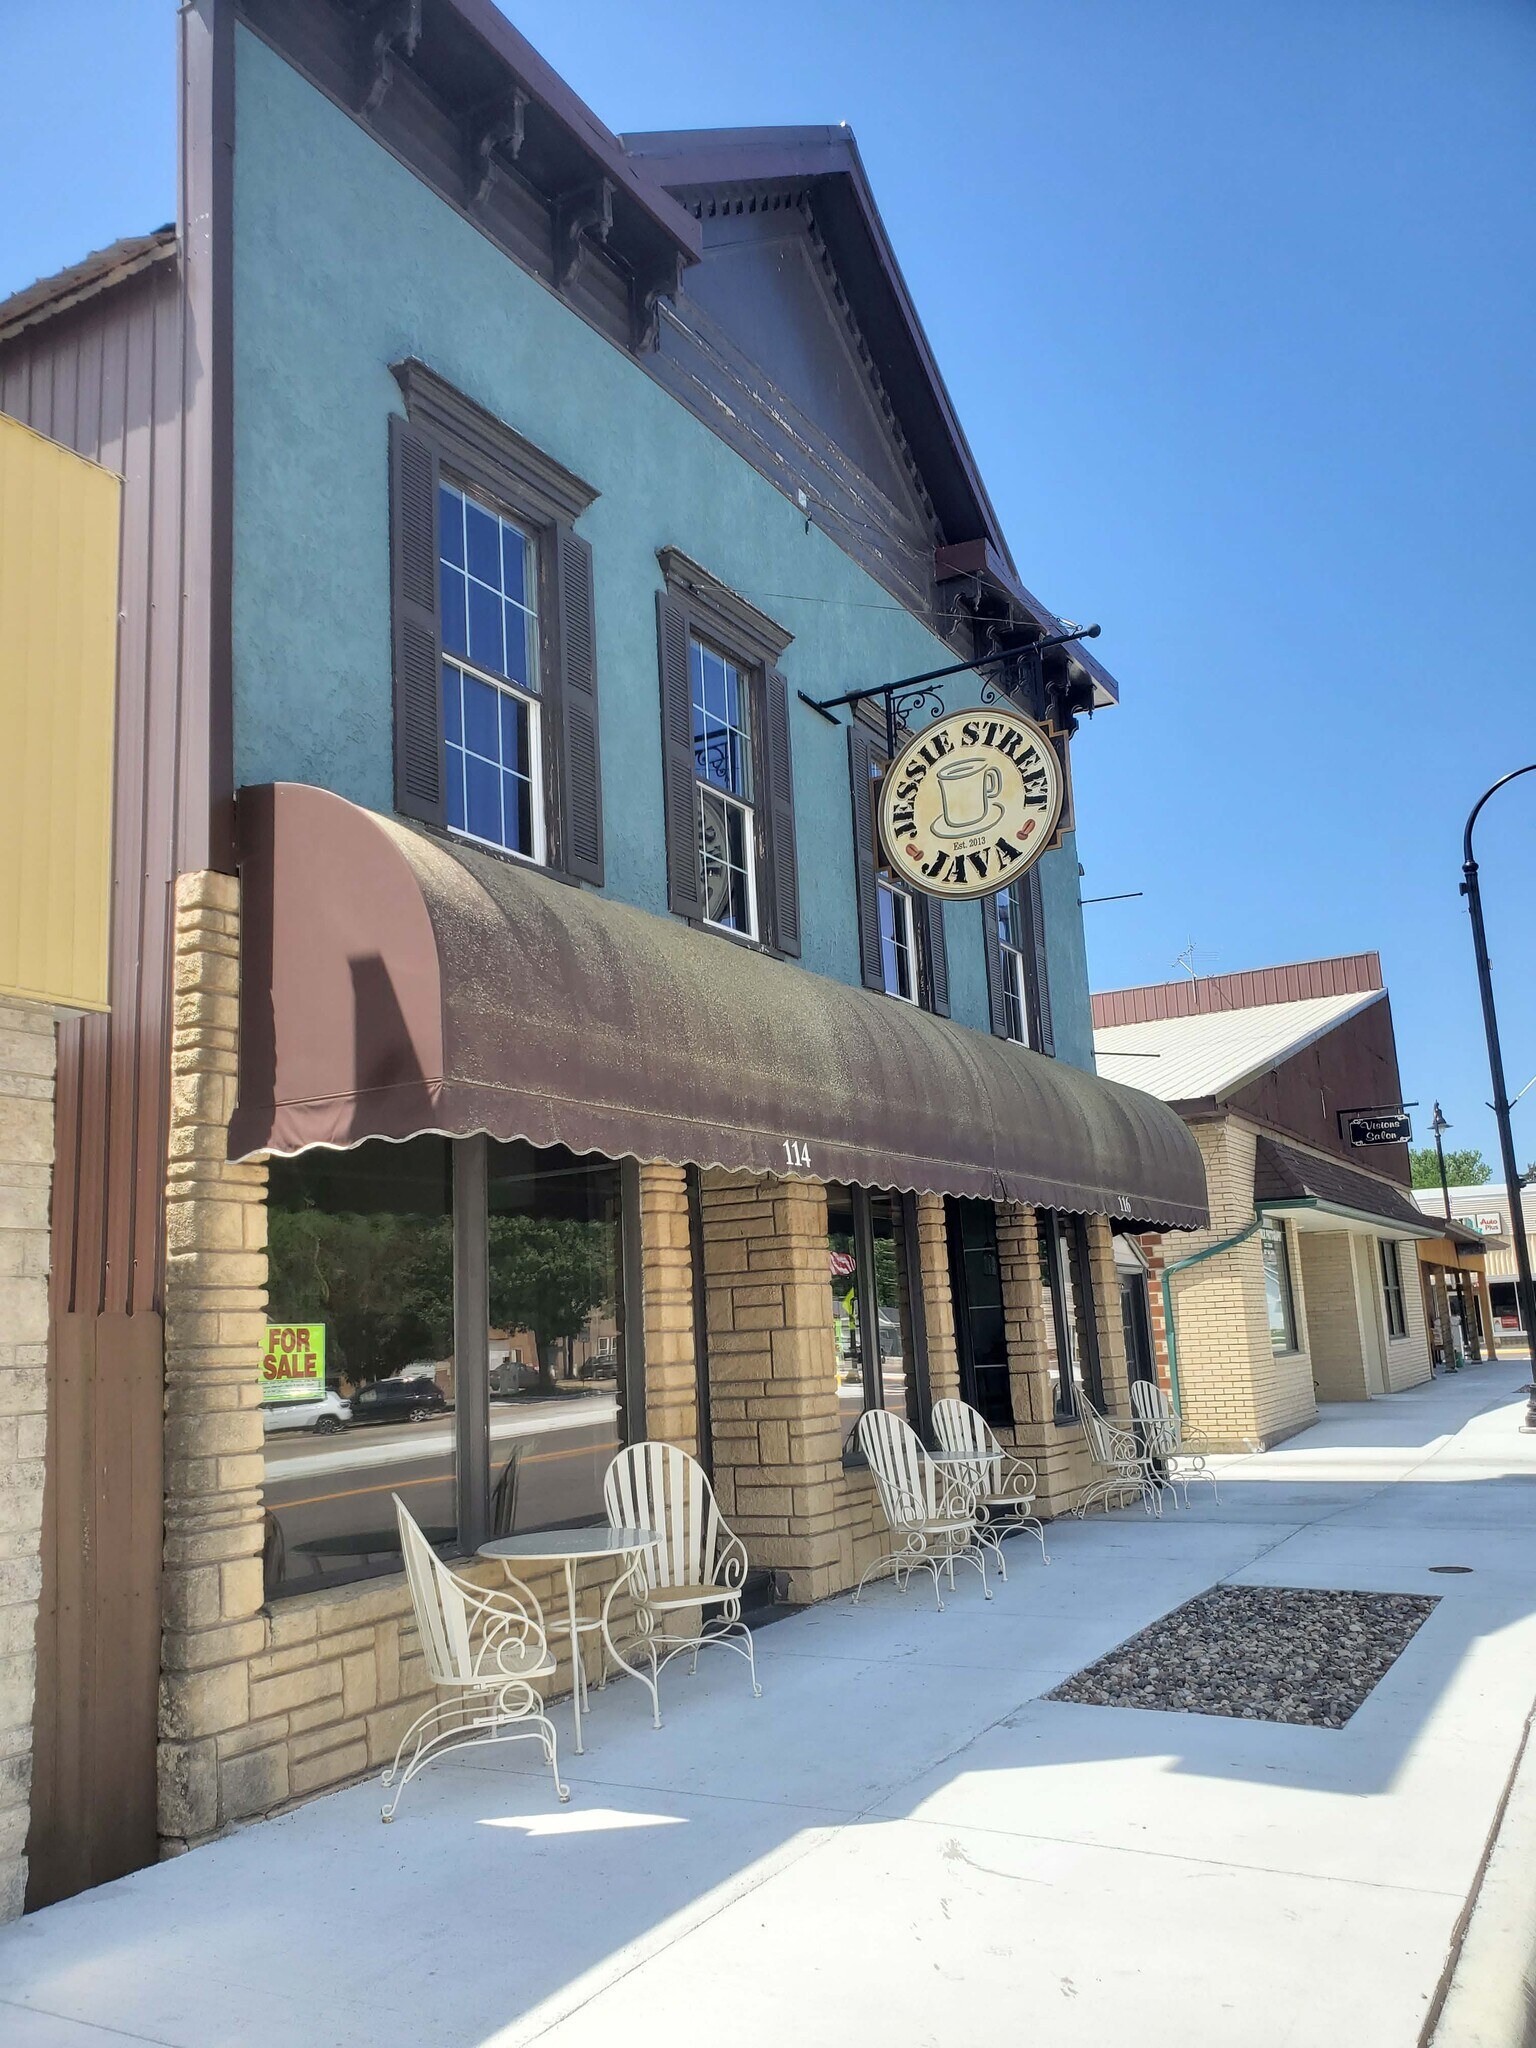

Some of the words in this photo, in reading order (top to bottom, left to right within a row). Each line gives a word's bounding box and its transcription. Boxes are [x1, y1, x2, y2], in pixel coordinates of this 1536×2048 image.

[893, 730, 954, 839] JESSIE
[961, 721, 1048, 812] STREET
[953, 841, 968, 851] Est.
[969, 836, 986, 847] 2013
[921, 837, 1023, 884] JAVA
[1360, 1121, 1400, 1130] Visions
[1365, 1131, 1397, 1141] Salon
[782, 1139, 812, 1168] 114
[1118, 1195, 1132, 1213] 116
[268, 1328, 311, 1353] FOR
[263, 1353, 317, 1380] SALE
